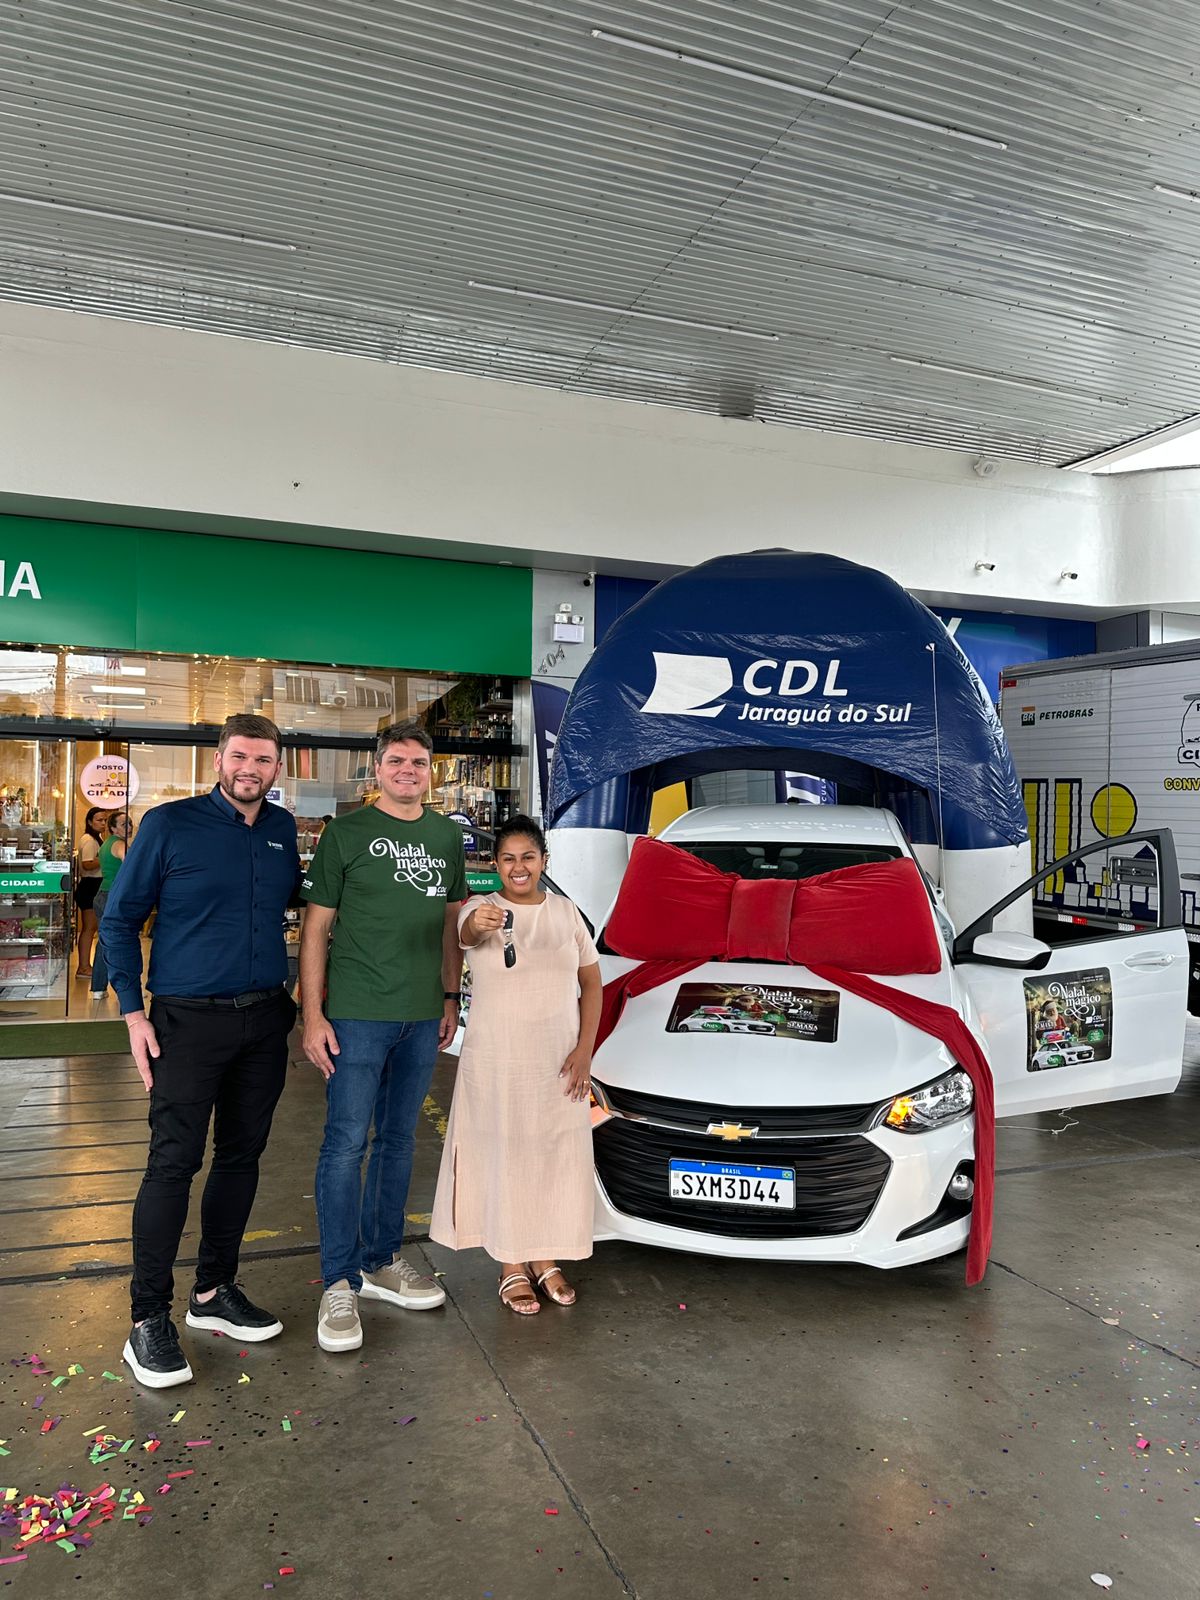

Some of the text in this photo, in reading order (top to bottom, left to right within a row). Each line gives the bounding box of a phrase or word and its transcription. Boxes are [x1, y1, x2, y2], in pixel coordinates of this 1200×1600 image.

[538, 644, 566, 675] 404
[742, 659, 848, 697] CDL
[738, 703, 912, 726] Jaraguá do Sul
[1022, 708, 1094, 722] BR PETROBRAS
[369, 837, 426, 859] Natal
[395, 854, 446, 873] mágico
[1, 879, 45, 887] CIDADE
[742, 985, 793, 997] Natal
[1048, 982, 1086, 999] Natal
[1065, 993, 1101, 1008] mágico
[721, 1167, 741, 1175] BRASIL
[681, 1174, 780, 1203] SXM3D44
